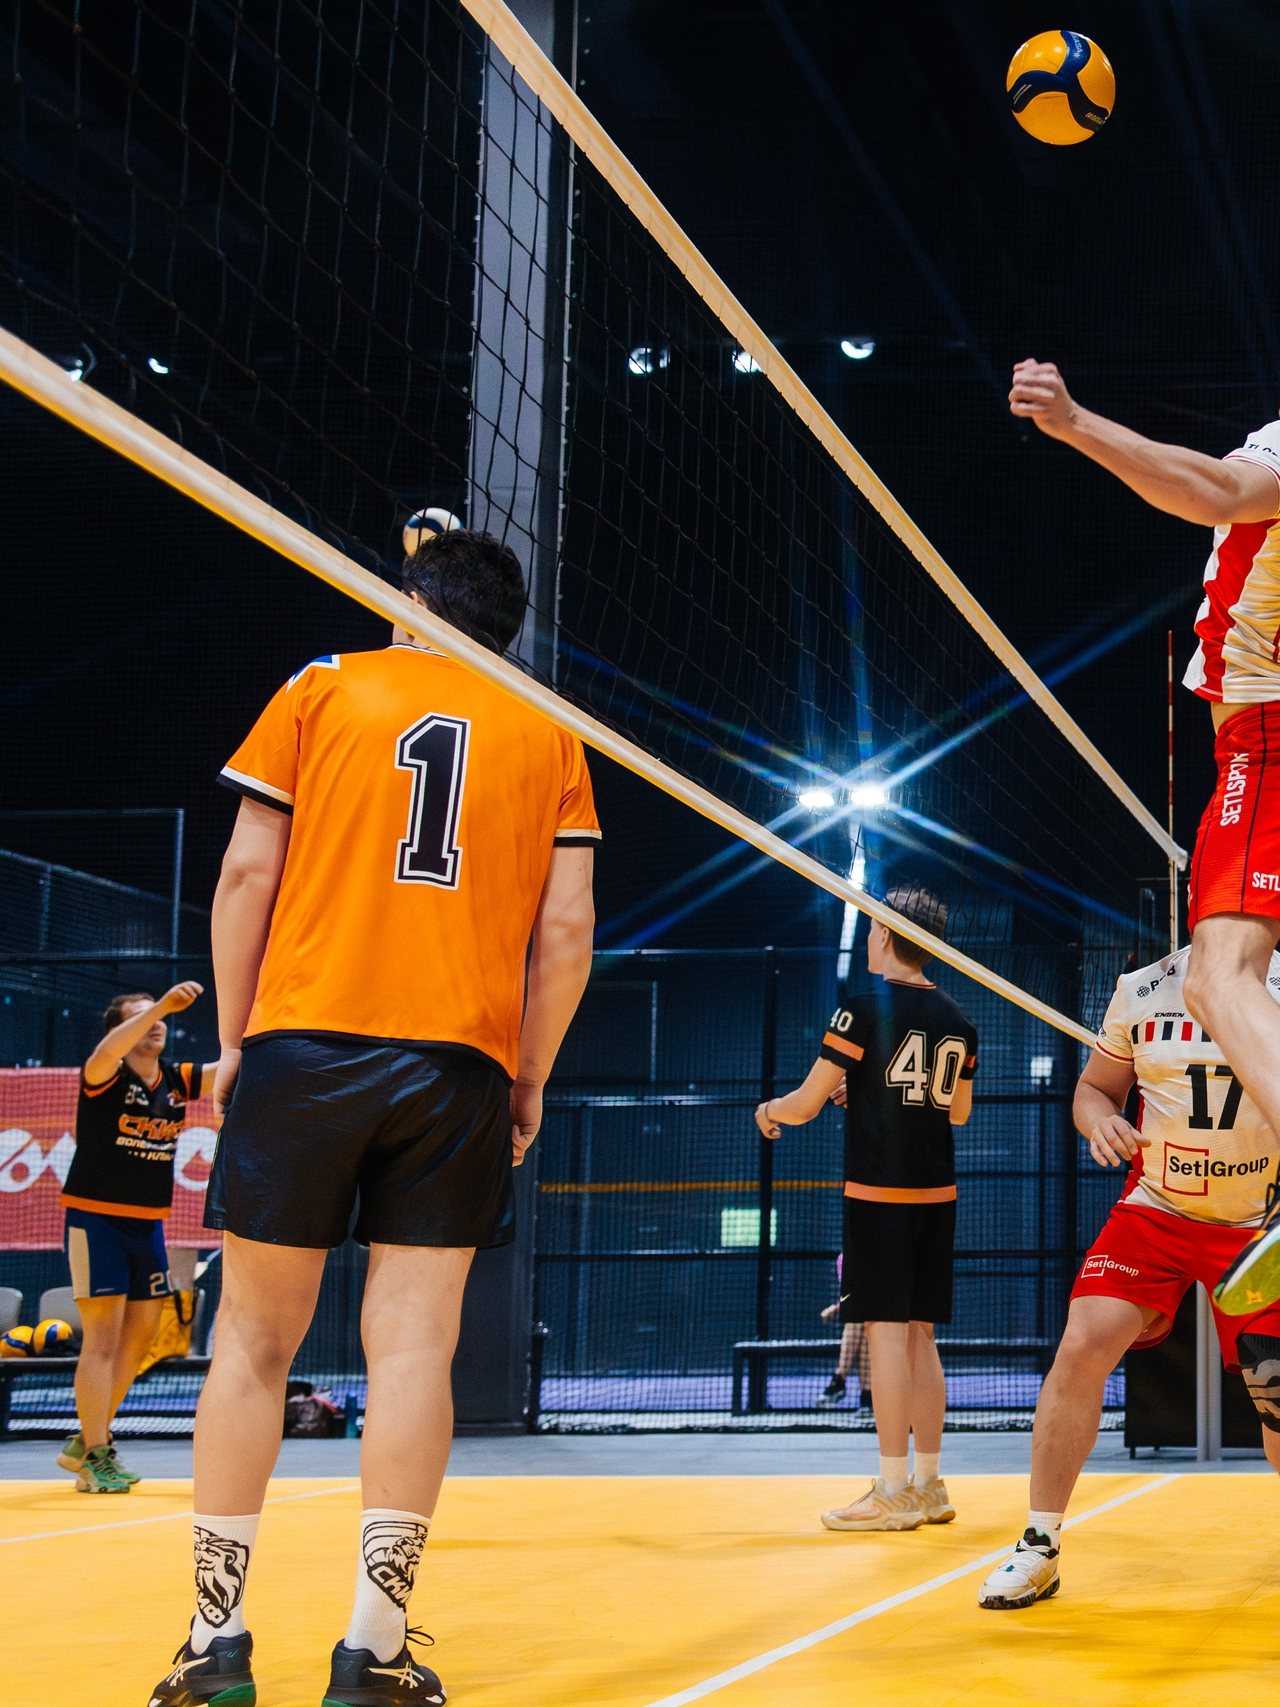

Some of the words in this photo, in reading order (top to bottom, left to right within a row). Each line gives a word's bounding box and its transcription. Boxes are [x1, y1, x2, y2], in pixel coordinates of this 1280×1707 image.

[394, 712, 471, 890] 1
[886, 1030, 968, 1110] 40
[1185, 1064, 1244, 1130] 17
[371, 1564, 413, 1604] СКИ
